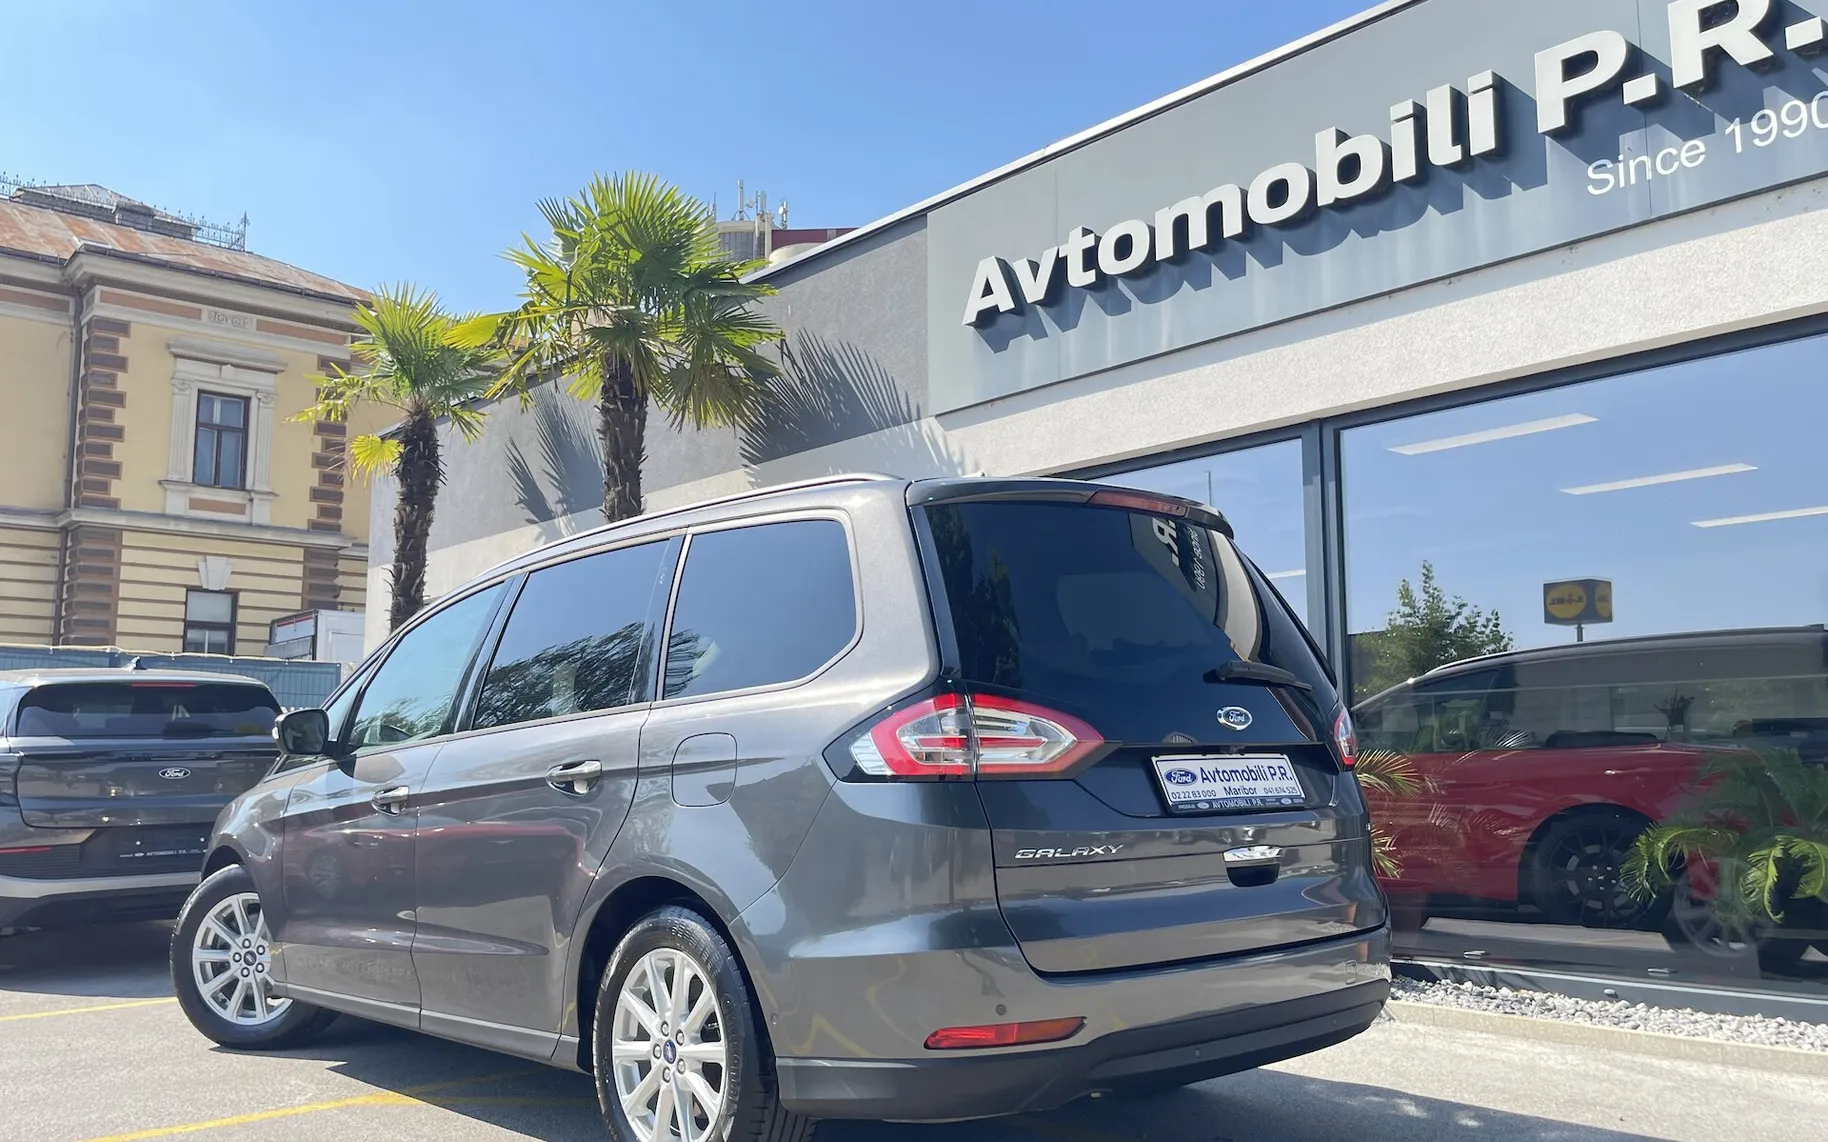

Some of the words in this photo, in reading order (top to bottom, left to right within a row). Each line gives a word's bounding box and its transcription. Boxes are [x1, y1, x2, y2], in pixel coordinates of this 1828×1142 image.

[1586, 138, 1707, 196] Since
[1724, 90, 1828, 154] 1990
[963, 69, 1500, 328] Avtomobili
[1534, 0, 1824, 134] P.R.
[1200, 764, 1269, 783] Avtomobili
[1267, 765, 1293, 781] P.R.
[1223, 785, 1258, 796] Maribor
[1015, 844, 1124, 859] GALAXY
